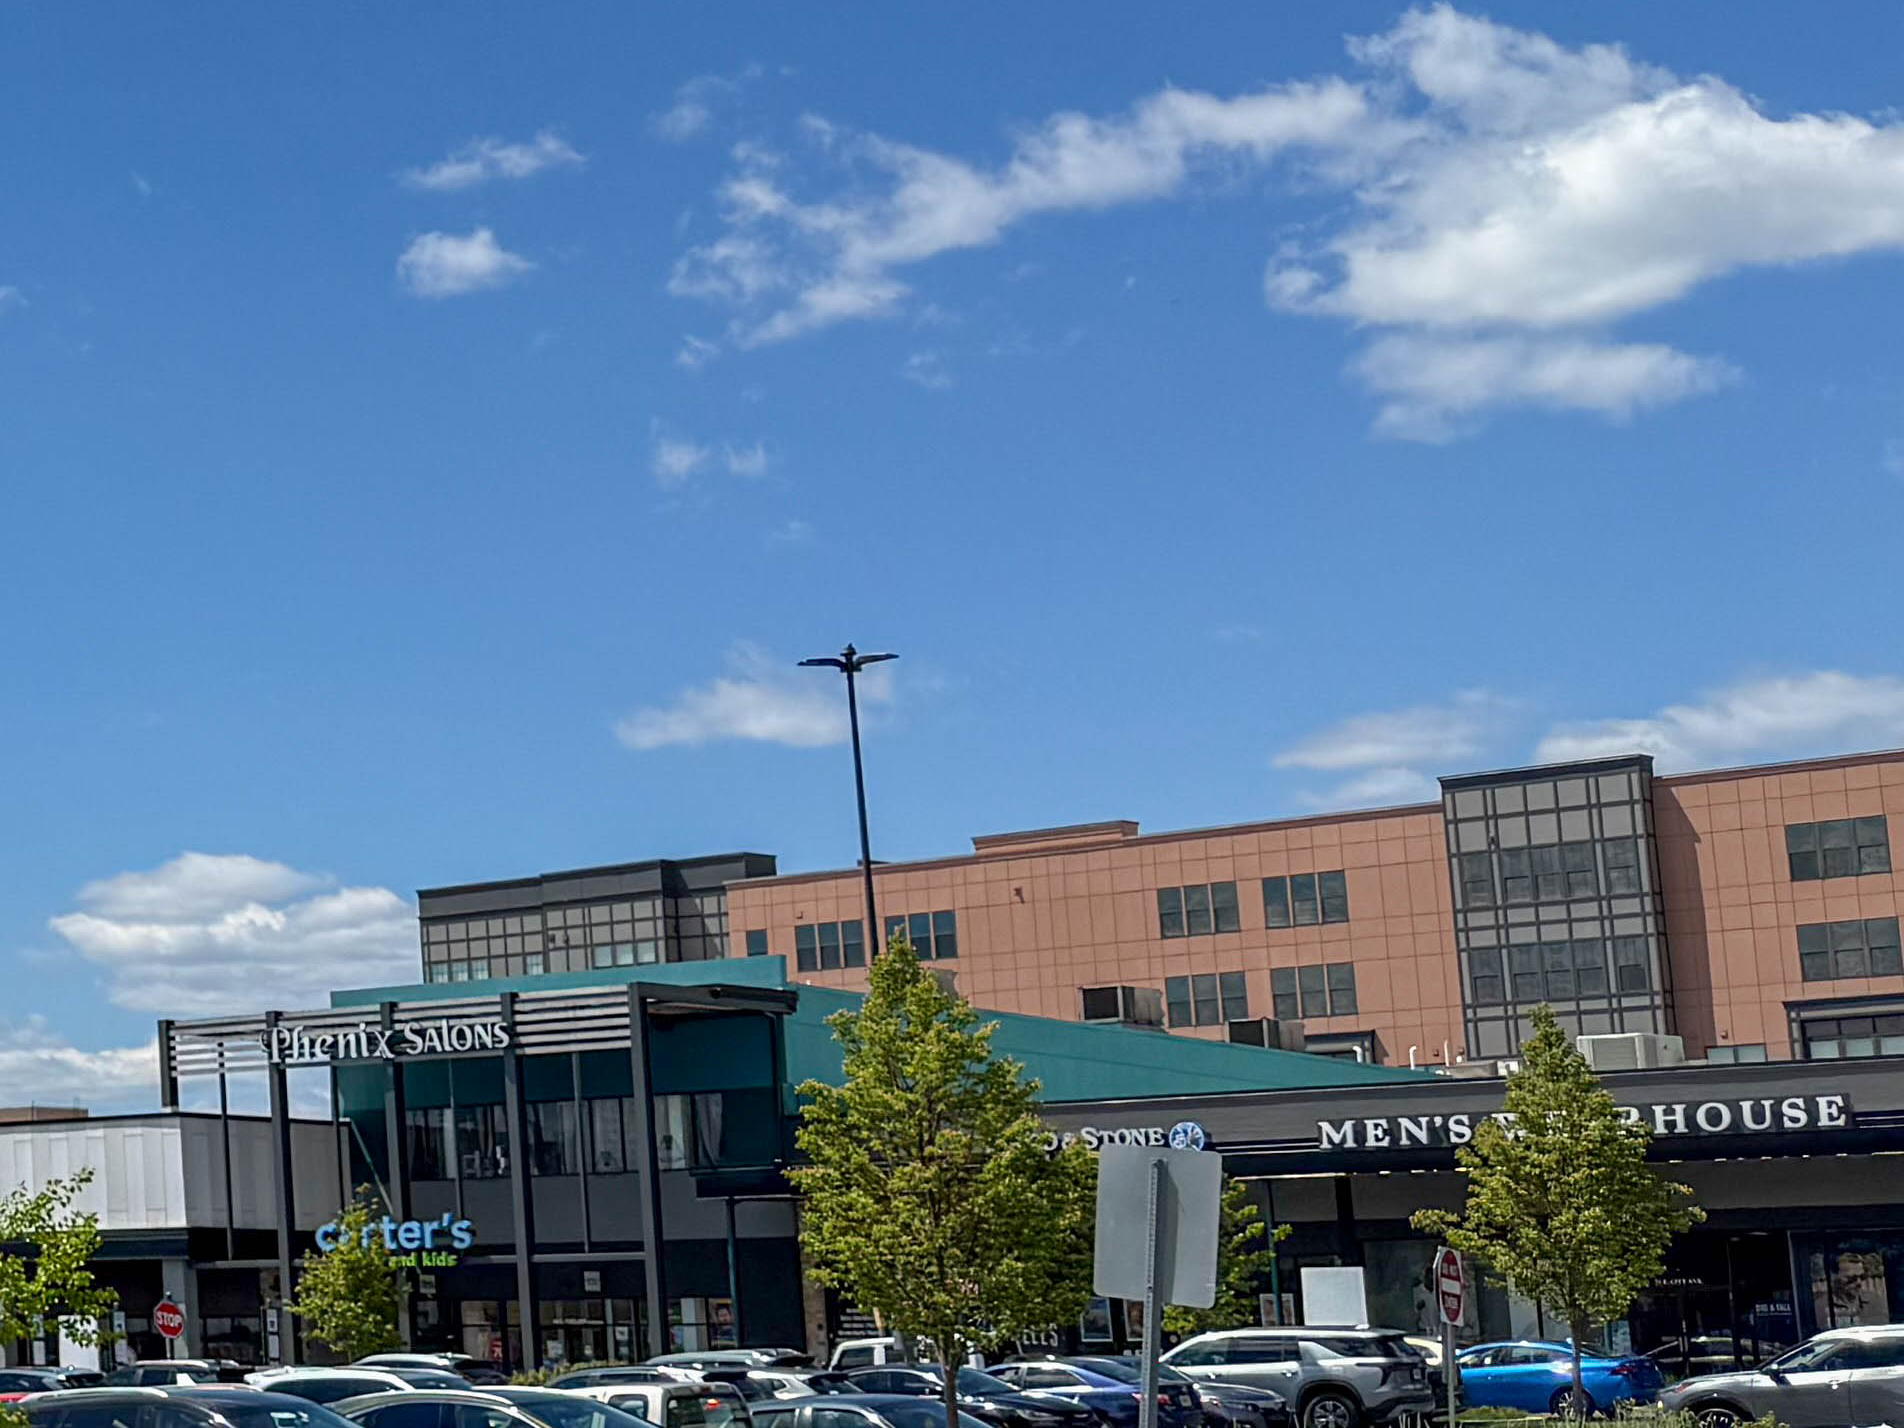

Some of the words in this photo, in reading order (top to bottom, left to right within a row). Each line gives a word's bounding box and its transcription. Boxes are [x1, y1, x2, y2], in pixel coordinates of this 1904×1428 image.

[259, 1022, 395, 1063] Phenix
[1317, 1115, 1472, 1150] MEN'S
[315, 1212, 473, 1252] crter's
[422, 1251, 458, 1267] kids
[156, 1310, 183, 1328] STOP
